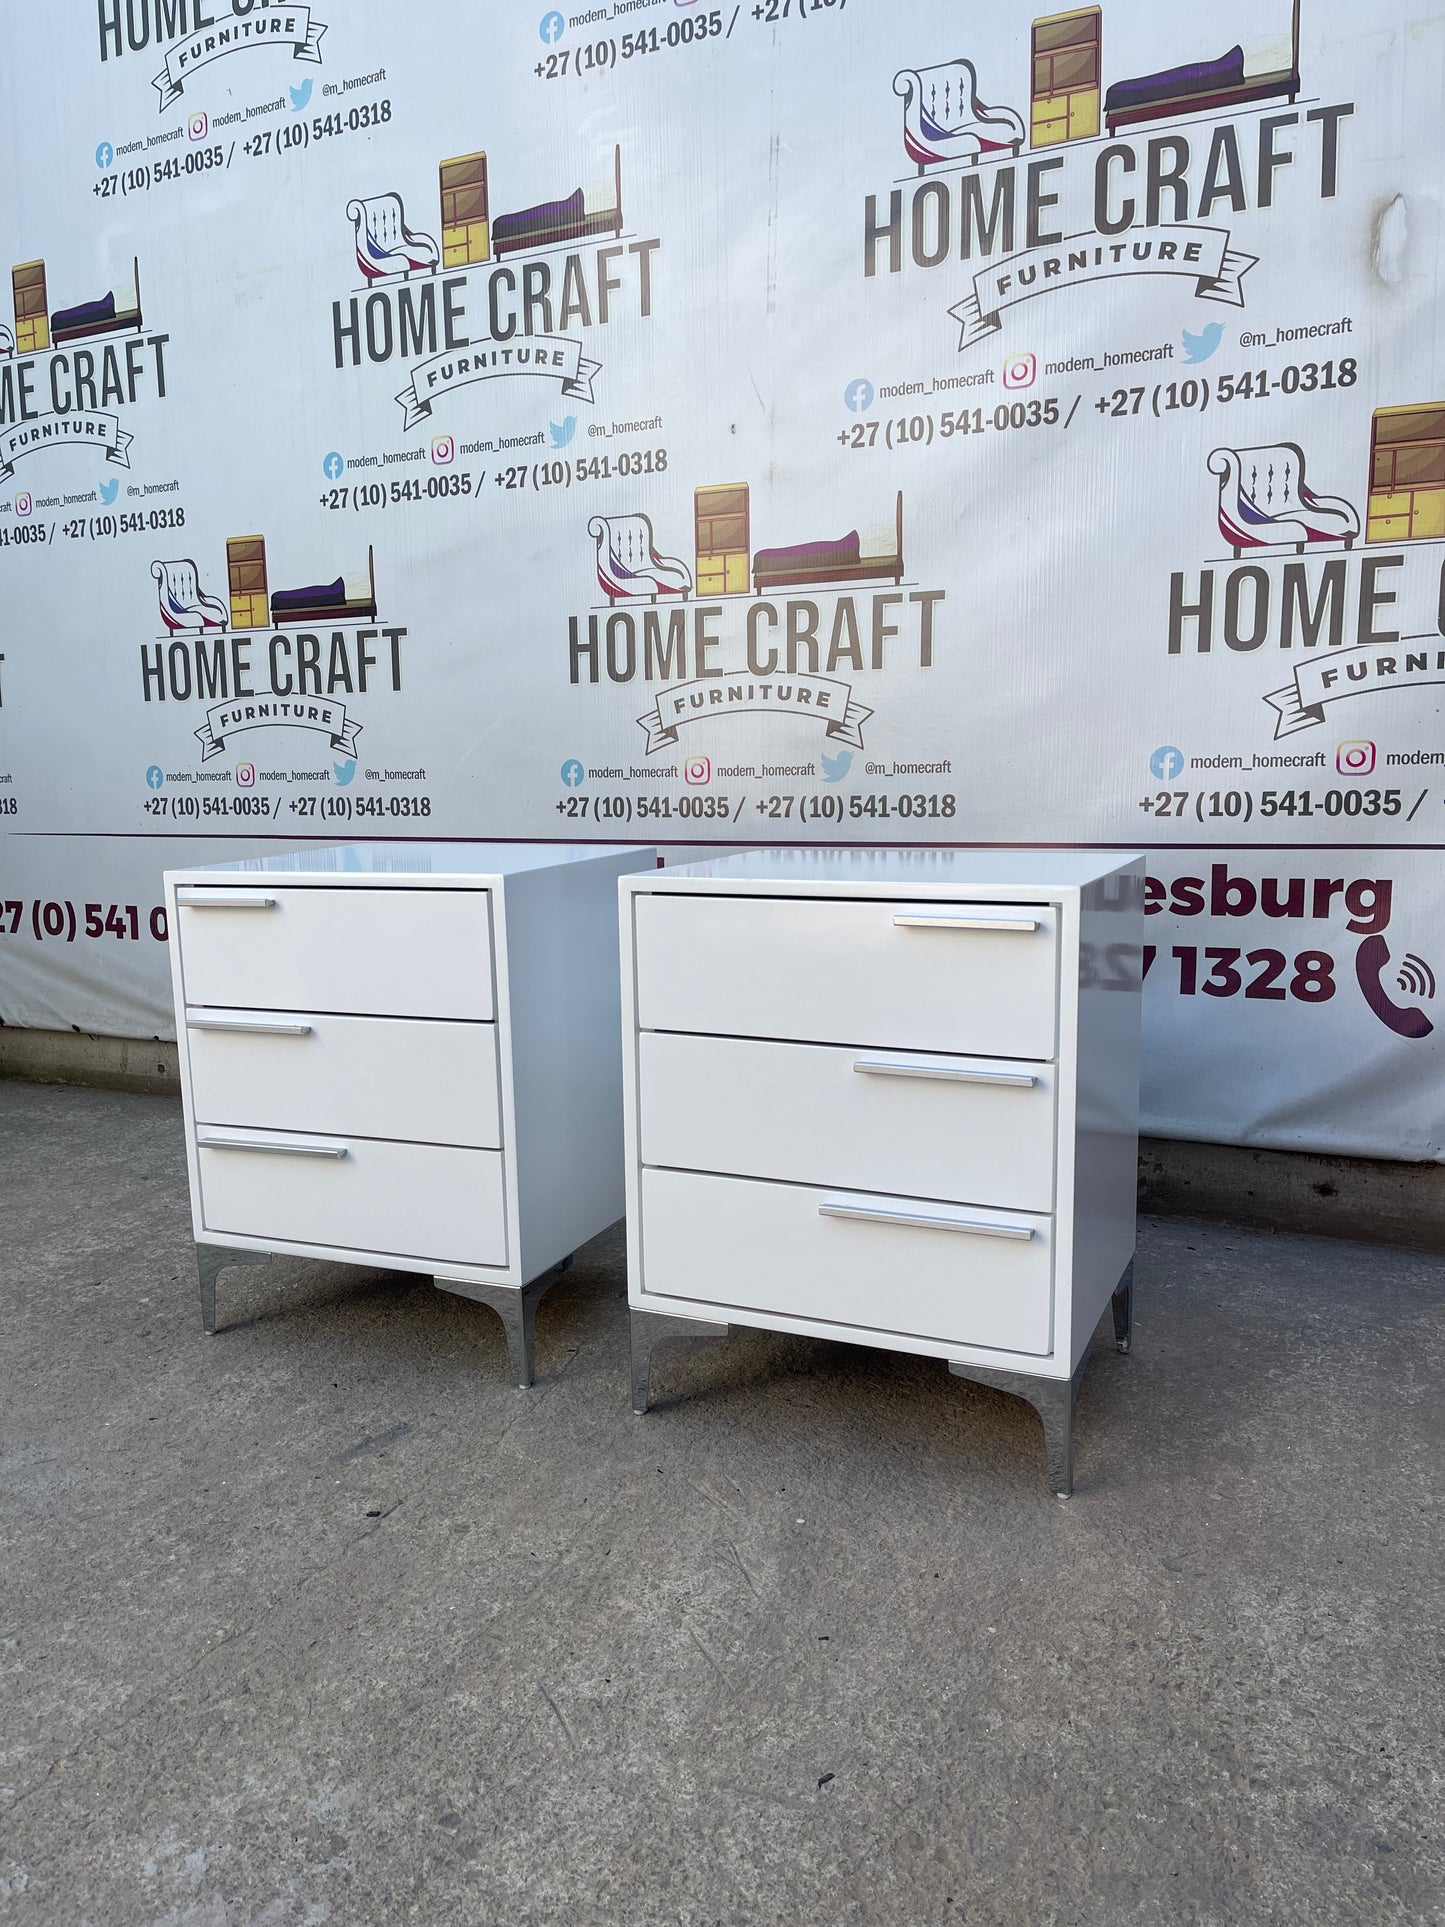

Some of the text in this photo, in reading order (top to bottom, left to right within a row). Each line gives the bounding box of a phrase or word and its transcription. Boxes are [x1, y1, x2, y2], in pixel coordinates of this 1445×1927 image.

[179, 18, 295, 68] FURNITURE
[534, 50, 570, 79] +27
[575, 39, 616, 76] (10)
[621, 10, 722, 59] 541-0035
[322, 68, 386, 96] @m_homecraft
[93, 174, 118, 198] +27
[122, 166, 150, 196] (10)
[154, 145, 223, 183] 541-0035
[243, 131, 271, 157] +27
[276, 122, 309, 155] (10)
[313, 99, 391, 140] 541-0318
[863, 102, 1354, 278] HOME CRAFT
[996, 242, 1202, 296] FURNITURE
[332, 238, 660, 369] HOME CRAFT
[1240, 317, 1352, 347] @m_homecraft
[50, 334, 169, 415] CRAFT
[427, 349, 564, 388] FURNITURE
[837, 421, 879, 449] +27
[886, 415, 933, 450] (10)
[940, 398, 1059, 437] 541-0035
[1095, 387, 1145, 417] +27
[1152, 378, 1209, 417] (10)
[1216, 358, 1357, 403] 541-0318
[9, 421, 106, 452] FURNITURE
[588, 415, 663, 438] @m_homecraft
[127, 480, 180, 497] @m_homecraft
[320, 488, 348, 510] +27
[353, 483, 386, 511] (10)
[391, 473, 471, 502] 541-0035
[495, 466, 528, 489] +27
[533, 461, 571, 491] (10)
[576, 449, 667, 481] 541-0318
[62, 519, 86, 538] +27
[90, 516, 117, 540] (10)
[120, 507, 185, 533] 541-0318
[1168, 555, 1404, 654] HOME
[568, 590, 945, 684] HOME CRAFT
[141, 627, 407, 702] HOME CRAFT
[220, 704, 332, 727] FURNITURE
[673, 685, 831, 714] FURNITURE
[365, 768, 426, 782] @m_homecraft
[865, 760, 952, 777] @m_homecraft
[144, 797, 168, 815] +27
[172, 797, 199, 819] (10)
[203, 797, 270, 815] 541-0035
[289, 797, 316, 816] +27
[321, 797, 352, 820] (10)
[356, 797, 431, 816] 541-0318
[556, 797, 589, 817] +27
[594, 797, 632, 822] (10)
[637, 796, 729, 818] 541-0035
[756, 796, 794, 818] +27
[800, 795, 843, 823] (10)
[849, 794, 956, 818] 541-0318
[1139, 792, 1189, 817] +27
[1196, 791, 1253, 823] (10)
[1260, 789, 1401, 816] 541-0035
[32, 900, 76, 942] (0)
[85, 904, 139, 940] 541
[1172, 946, 1336, 1002] 1328
